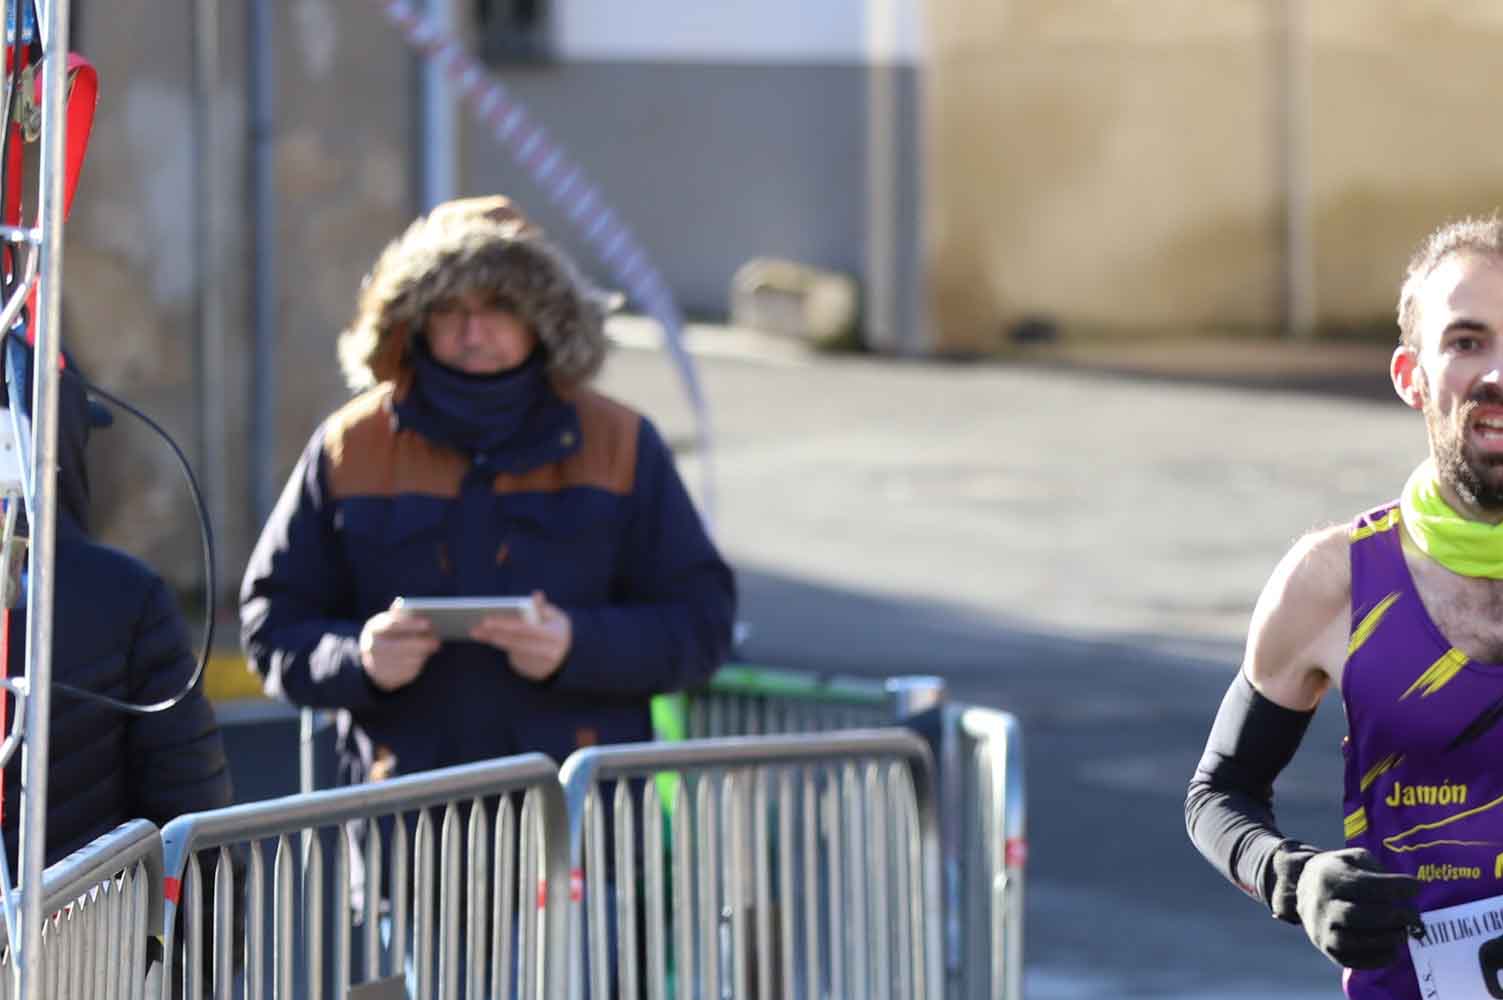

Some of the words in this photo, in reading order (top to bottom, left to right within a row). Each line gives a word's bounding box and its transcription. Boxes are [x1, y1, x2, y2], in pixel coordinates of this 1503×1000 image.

[1385, 779, 1467, 808] Jamón
[1416, 863, 1481, 882] Atletismo
[1449, 915, 1482, 941] LIGA
